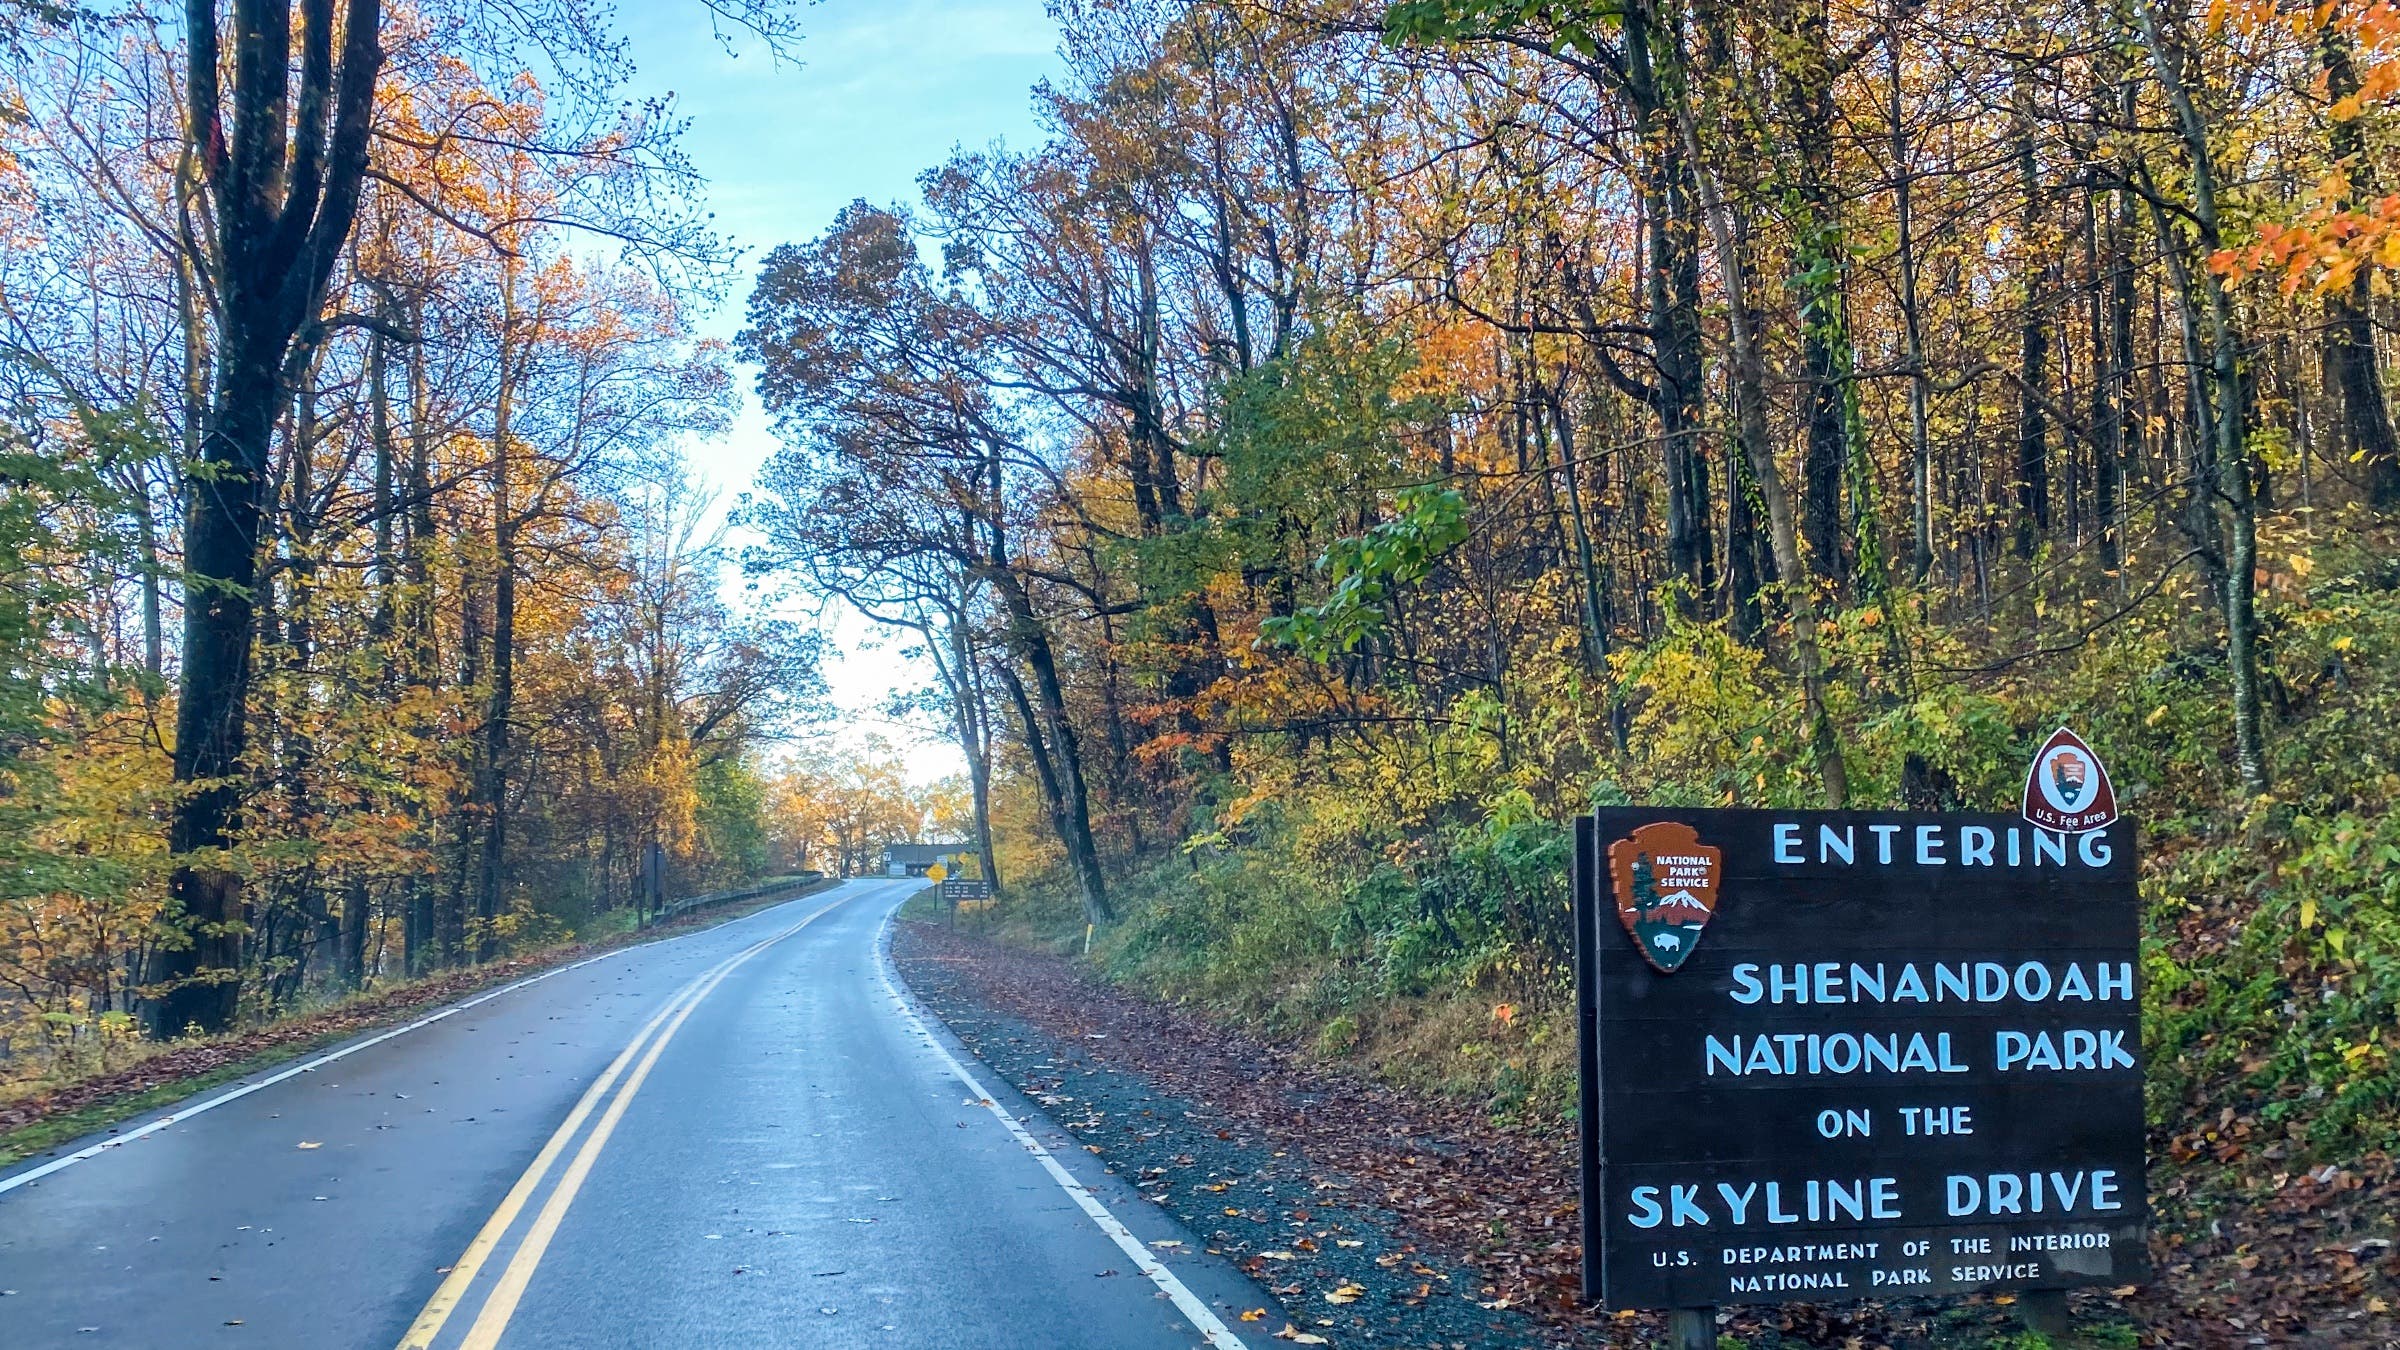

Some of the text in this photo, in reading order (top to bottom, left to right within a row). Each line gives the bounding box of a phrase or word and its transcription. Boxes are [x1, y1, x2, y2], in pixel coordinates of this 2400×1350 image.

[2036, 808, 2107, 827] U.S. Fee Area
[1656, 856, 1712, 866] NATIONAL
[1773, 823, 2113, 868] ENTERING
[1661, 878, 1709, 888] SERVICE
[1669, 867, 1699, 877] PARK
[1729, 960, 2134, 1005] SHENANDOAH
[1705, 1029, 2136, 1076] NATIONAL PARK
[1817, 1106, 1974, 1139] ON THE
[1627, 1170, 2122, 1229] SKYLINE DRIVE
[1653, 1232, 2111, 1268] U.S. DEPARTMENT OF THE INTERIOR
[1730, 1262, 2040, 1293] NATIONAL PARK SERVICE
